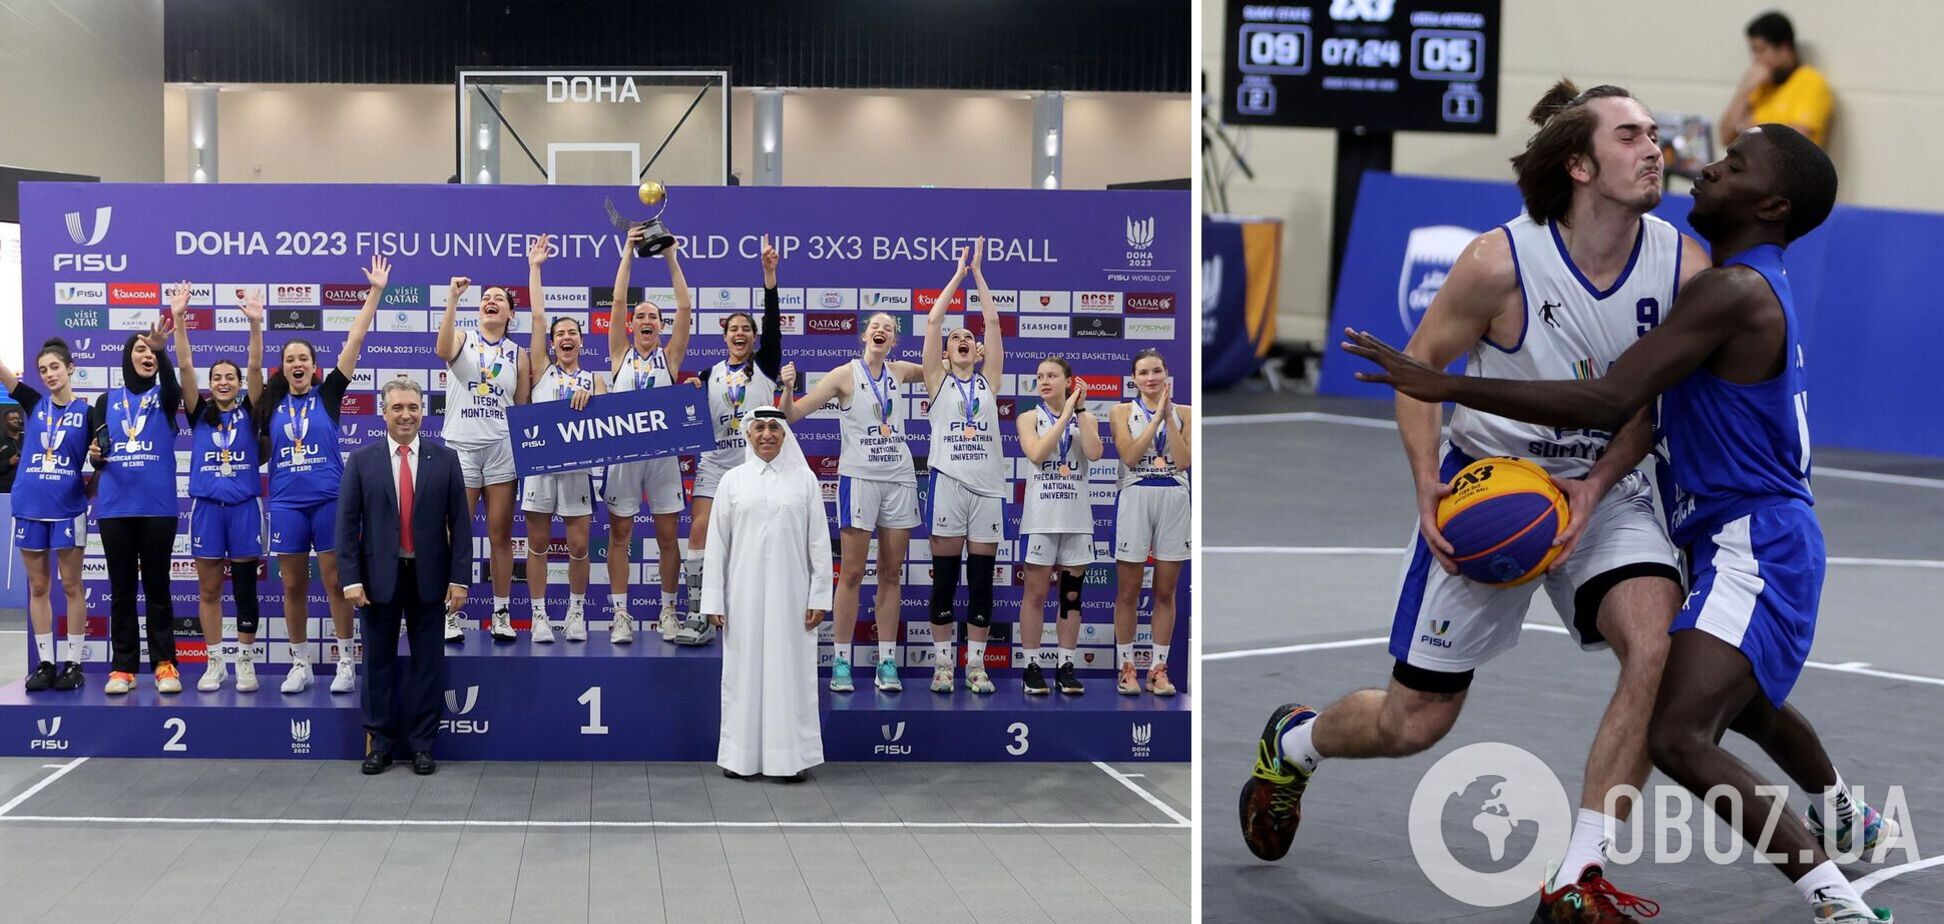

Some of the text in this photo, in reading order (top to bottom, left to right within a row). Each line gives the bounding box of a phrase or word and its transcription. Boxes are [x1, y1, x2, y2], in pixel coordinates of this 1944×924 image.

[1251, 31, 1300, 66] 09
[1321, 38, 1401, 68] 07:24
[1423, 38, 1473, 71] 05
[547, 77, 641, 102] DOHA
[175, 231, 268, 256] DOHA
[276, 231, 347, 256] 2023
[357, 232, 420, 257] FISU
[808, 236, 863, 259] 3X3
[54, 254, 127, 272] FISU
[277, 286, 312, 298] QCSF
[325, 290, 357, 300] QATAR
[395, 286, 418, 294] visit
[385, 295, 418, 304] QATAR
[1128, 298, 1159, 307] QATAR
[75, 310, 98, 318] visit
[1636, 298, 1659, 338] 9
[64, 318, 98, 327] QATAR
[808, 319, 840, 329] QATAR
[1021, 323, 1068, 331] SEASHORE
[1015, 351, 1045, 359] WORLD
[576, 376, 591, 391] 13
[976, 378, 986, 390] 3
[64, 412, 83, 427] 20
[557, 410, 668, 443] WINNER
[521, 439, 546, 449] FISU
[953, 443, 986, 451] NATIONAL
[950, 453, 988, 461] UNIVERSITY
[1090, 466, 1116, 476] print
[1043, 483, 1076, 491] NATIONAL
[1040, 492, 1078, 500] UNIVERSITY
[633, 598, 657, 606] DOHA
[1421, 635, 1452, 649] FISU
[577, 686, 609, 734] 1
[438, 720, 489, 734] FISU
[163, 717, 187, 751] 2
[1005, 722, 1030, 756] 3
[31, 740, 68, 750] FISU
[874, 745, 912, 755] FISU
